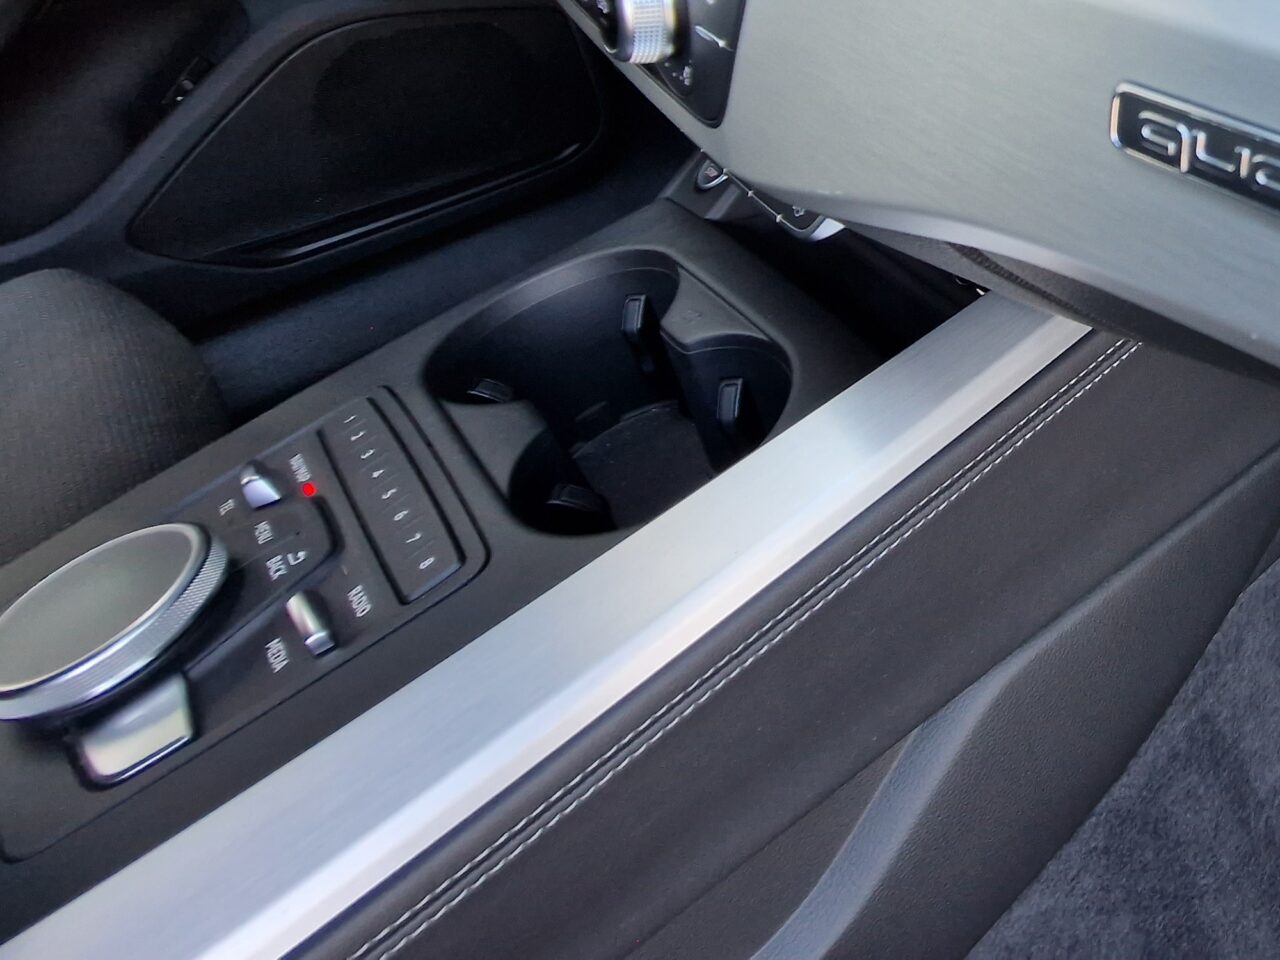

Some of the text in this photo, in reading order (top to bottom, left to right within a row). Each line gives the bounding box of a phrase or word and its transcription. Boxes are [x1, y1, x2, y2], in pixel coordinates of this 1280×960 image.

[343, 415, 357, 424] 1
[351, 430, 366, 441] 2
[360, 448, 375, 459] 3
[371, 468, 385, 479] 4
[381, 488, 397, 500] 5
[393, 509, 409, 521] 6
[254, 521, 274, 545] MENU
[405, 531, 422, 543] 7
[265, 554, 288, 581] BACK
[419, 556, 435, 570] 8
[347, 584, 372, 617] RADIO
[265, 637, 290, 673] MEDIA
